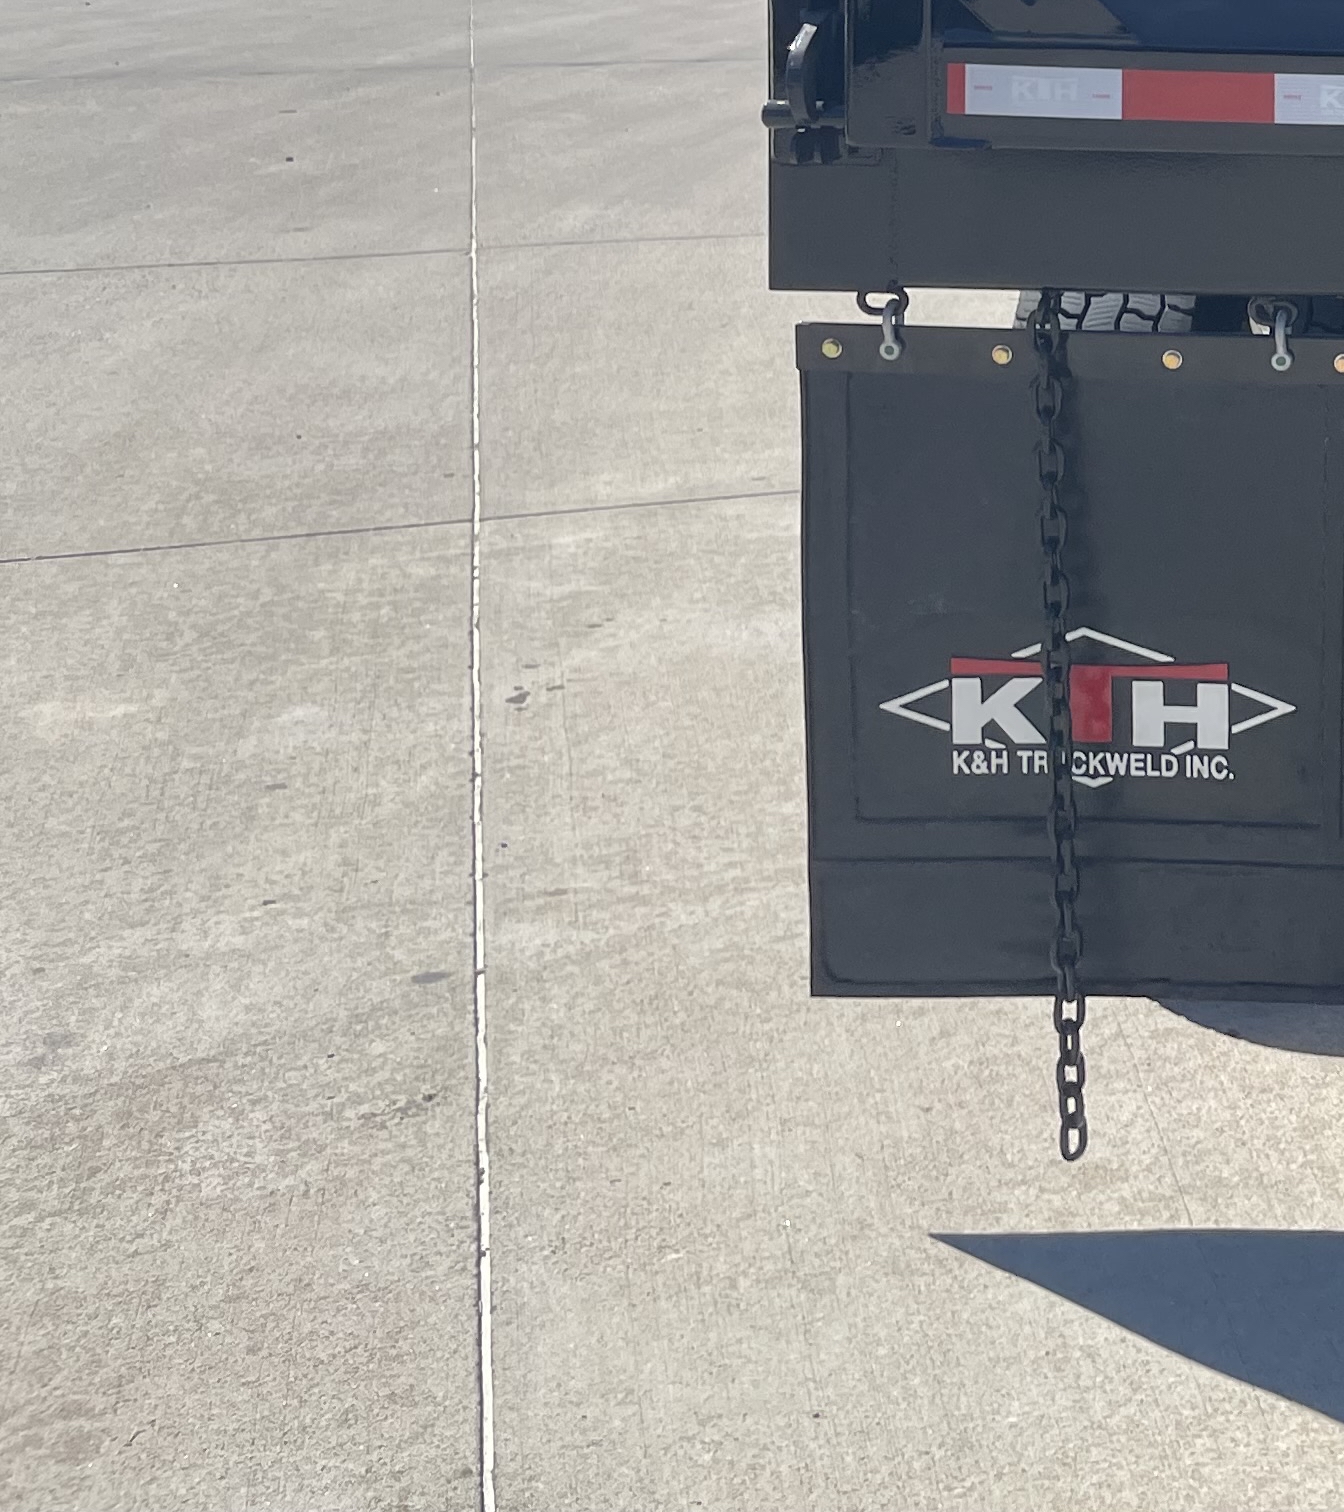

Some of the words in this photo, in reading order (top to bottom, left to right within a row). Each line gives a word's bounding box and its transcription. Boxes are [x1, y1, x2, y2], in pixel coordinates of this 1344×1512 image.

[952, 749, 1010, 776] K&H
[1016, 749, 1180, 778] TRCKWELD
[1184, 754, 1236, 780] INC.
